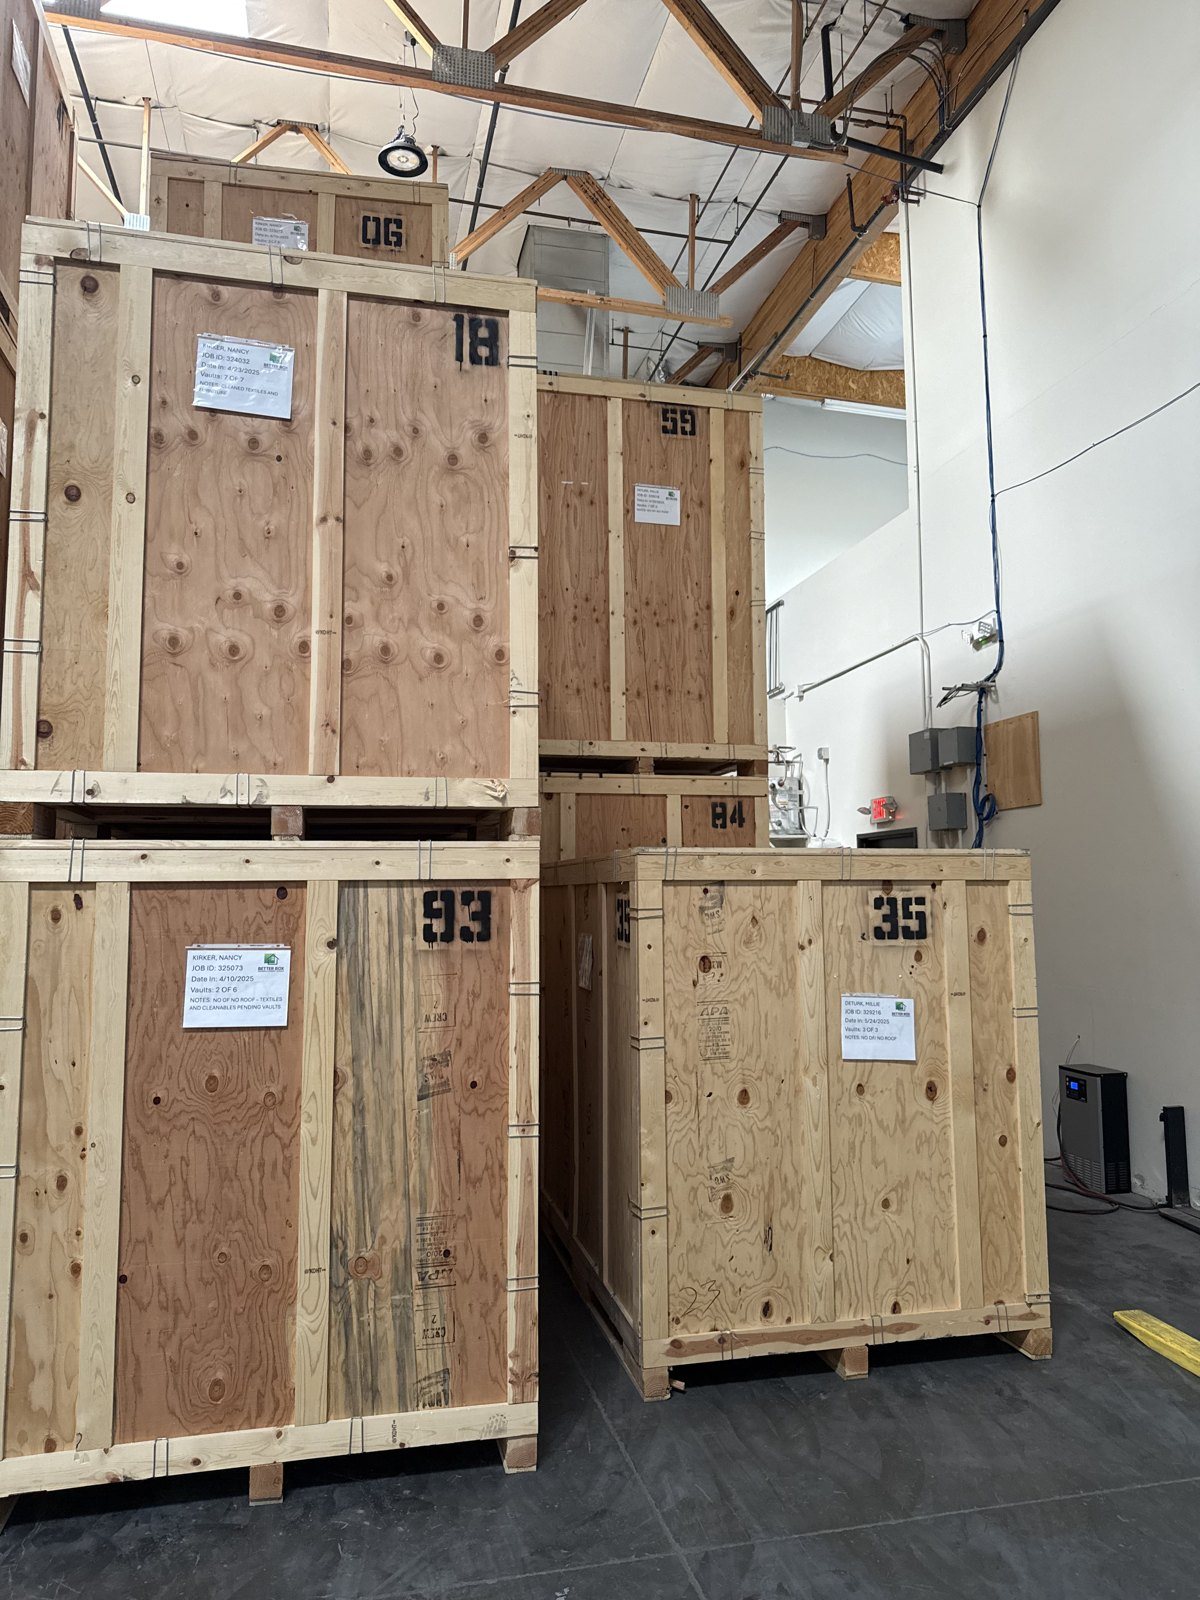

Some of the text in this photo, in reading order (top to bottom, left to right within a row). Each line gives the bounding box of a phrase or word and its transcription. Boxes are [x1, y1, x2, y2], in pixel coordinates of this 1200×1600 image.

[228, 346, 250, 354] NANCY
[452, 314, 499, 366] 18
[226, 355, 250, 364] 324032
[228, 366, 260, 376] 4/23/2025
[661, 407, 696, 436] 59
[711, 800, 745, 829] 84
[423, 890, 492, 943] 93
[874, 896, 927, 940] 35
[700, 1006, 729, 1016] APA
